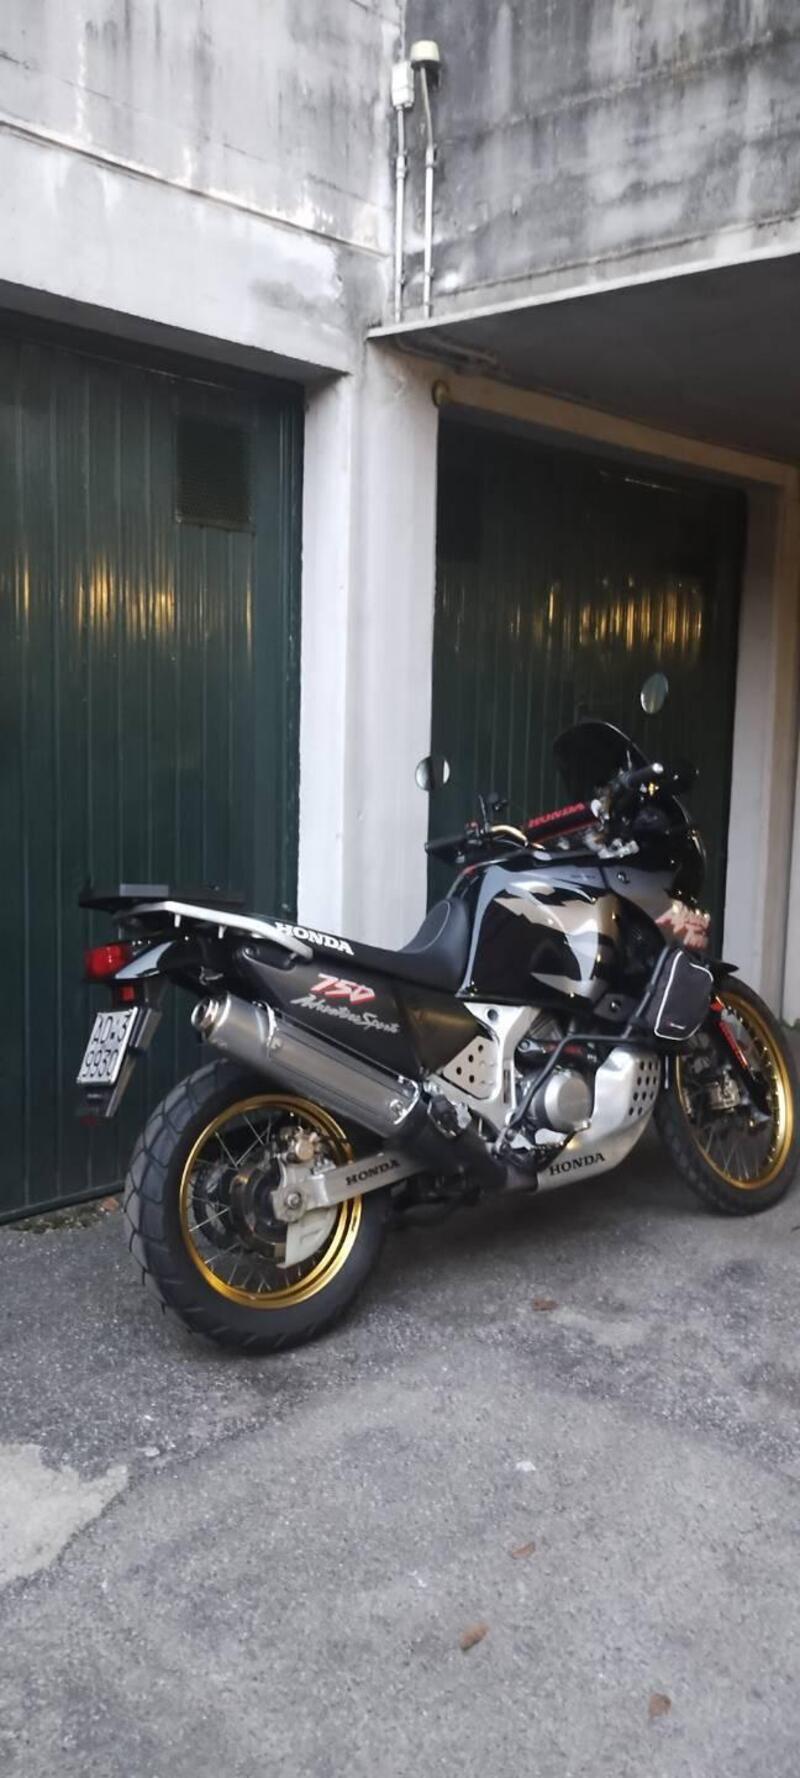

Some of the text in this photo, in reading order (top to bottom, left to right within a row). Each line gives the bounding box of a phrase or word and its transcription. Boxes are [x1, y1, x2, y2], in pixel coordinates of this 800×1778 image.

[528, 802, 585, 828] HONDA
[274, 921, 354, 955] HONDA
[310, 973, 375, 1005] 750
[82, 1049, 119, 1077] 9930
[346, 1159, 401, 1185] HONDA
[549, 1152, 605, 1176] HONDA
